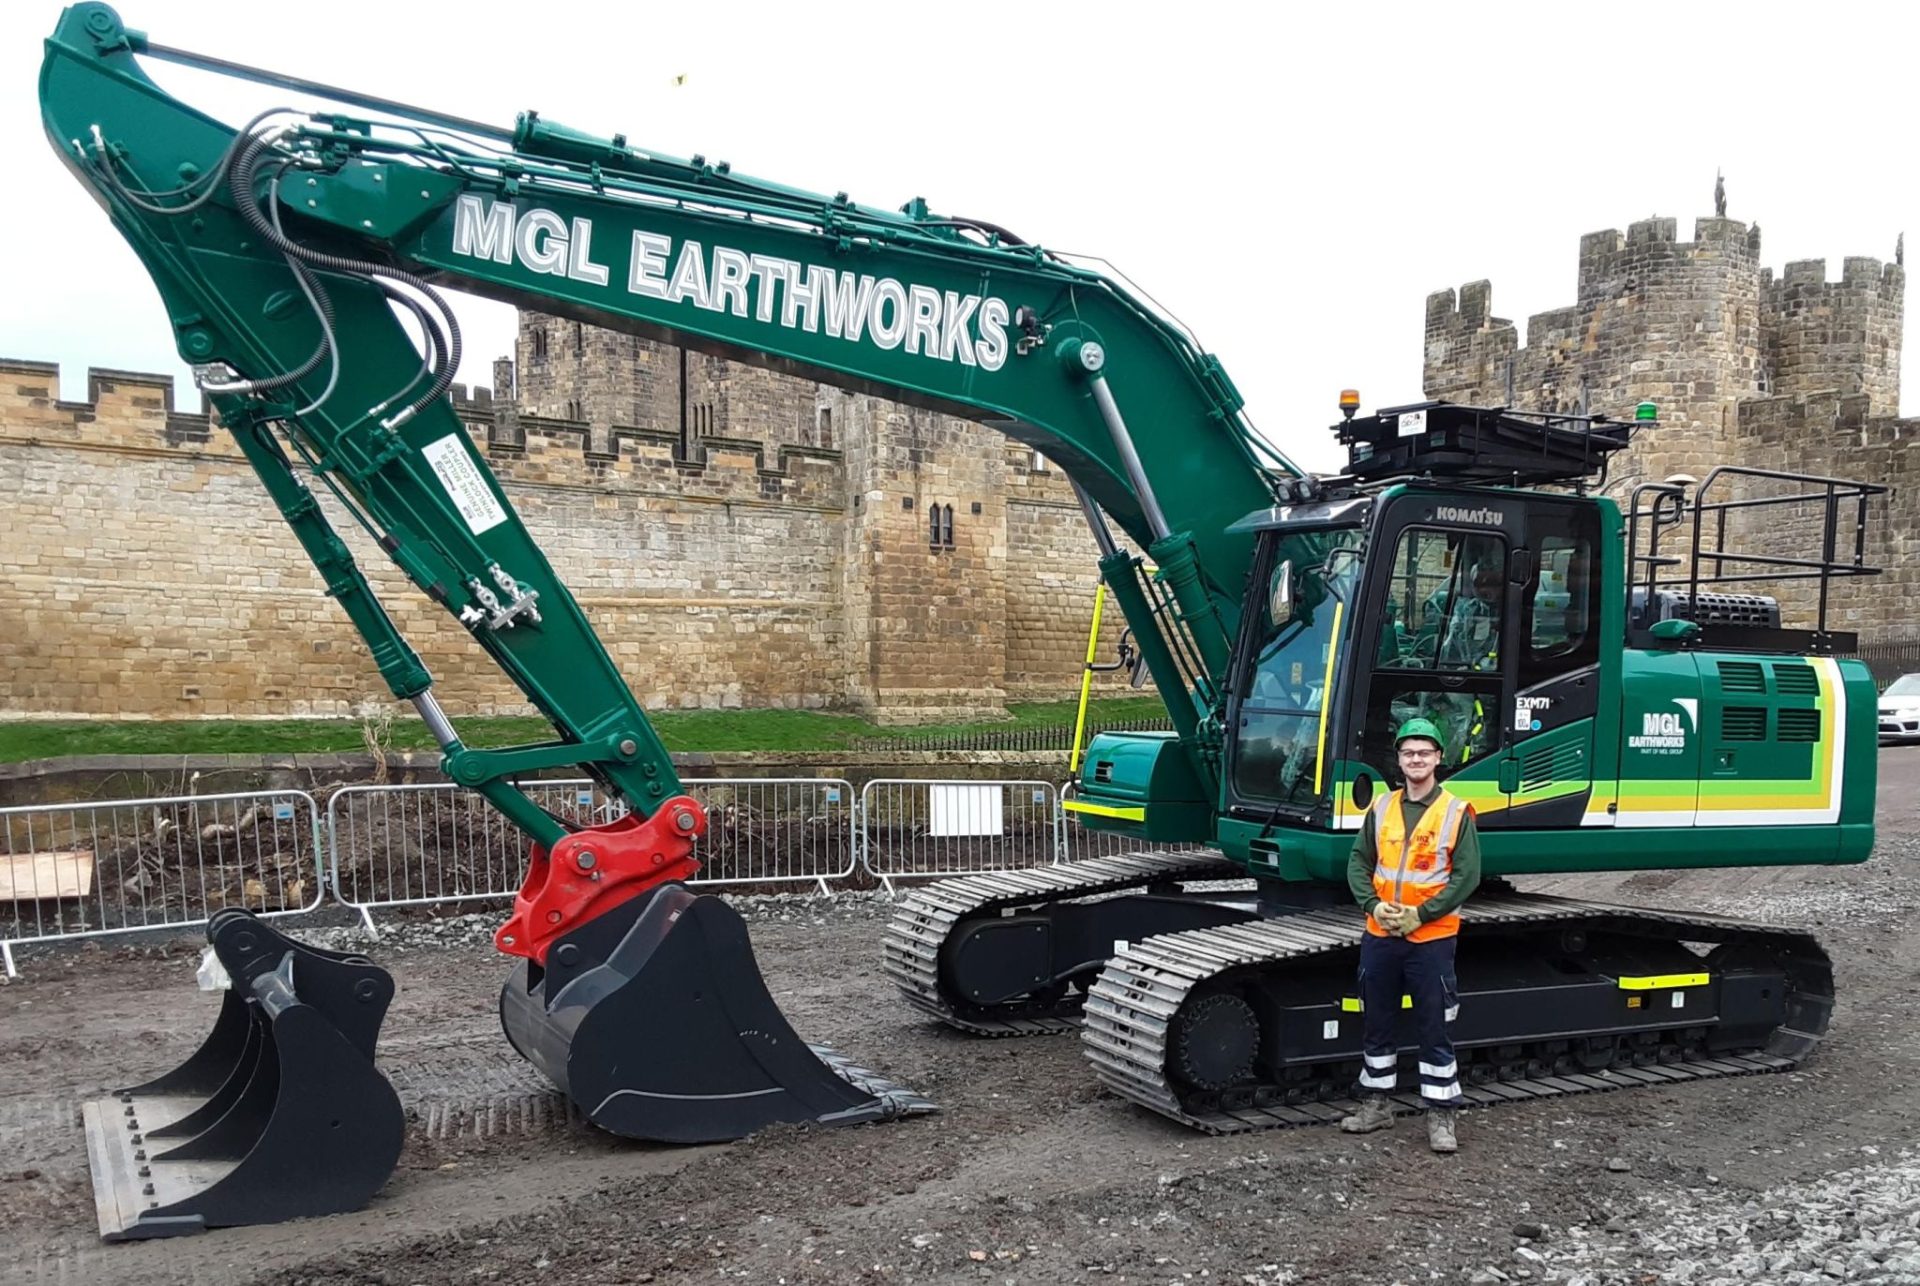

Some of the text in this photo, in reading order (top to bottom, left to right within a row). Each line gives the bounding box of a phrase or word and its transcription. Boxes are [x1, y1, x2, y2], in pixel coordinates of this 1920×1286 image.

[452, 193, 1010, 373] MGL EARTHWORKS
[439, 453, 462, 482] MILLER
[444, 442, 471, 479] COUPLER
[458, 482, 485, 517] GENUINE
[468, 479, 496, 519] TWINLOCK
[1437, 506, 1503, 526] KOMATSU
[1516, 697, 1550, 709] EXM71
[1643, 713, 1685, 735] MGL
[1629, 736, 1685, 748] EARTHWORKS
